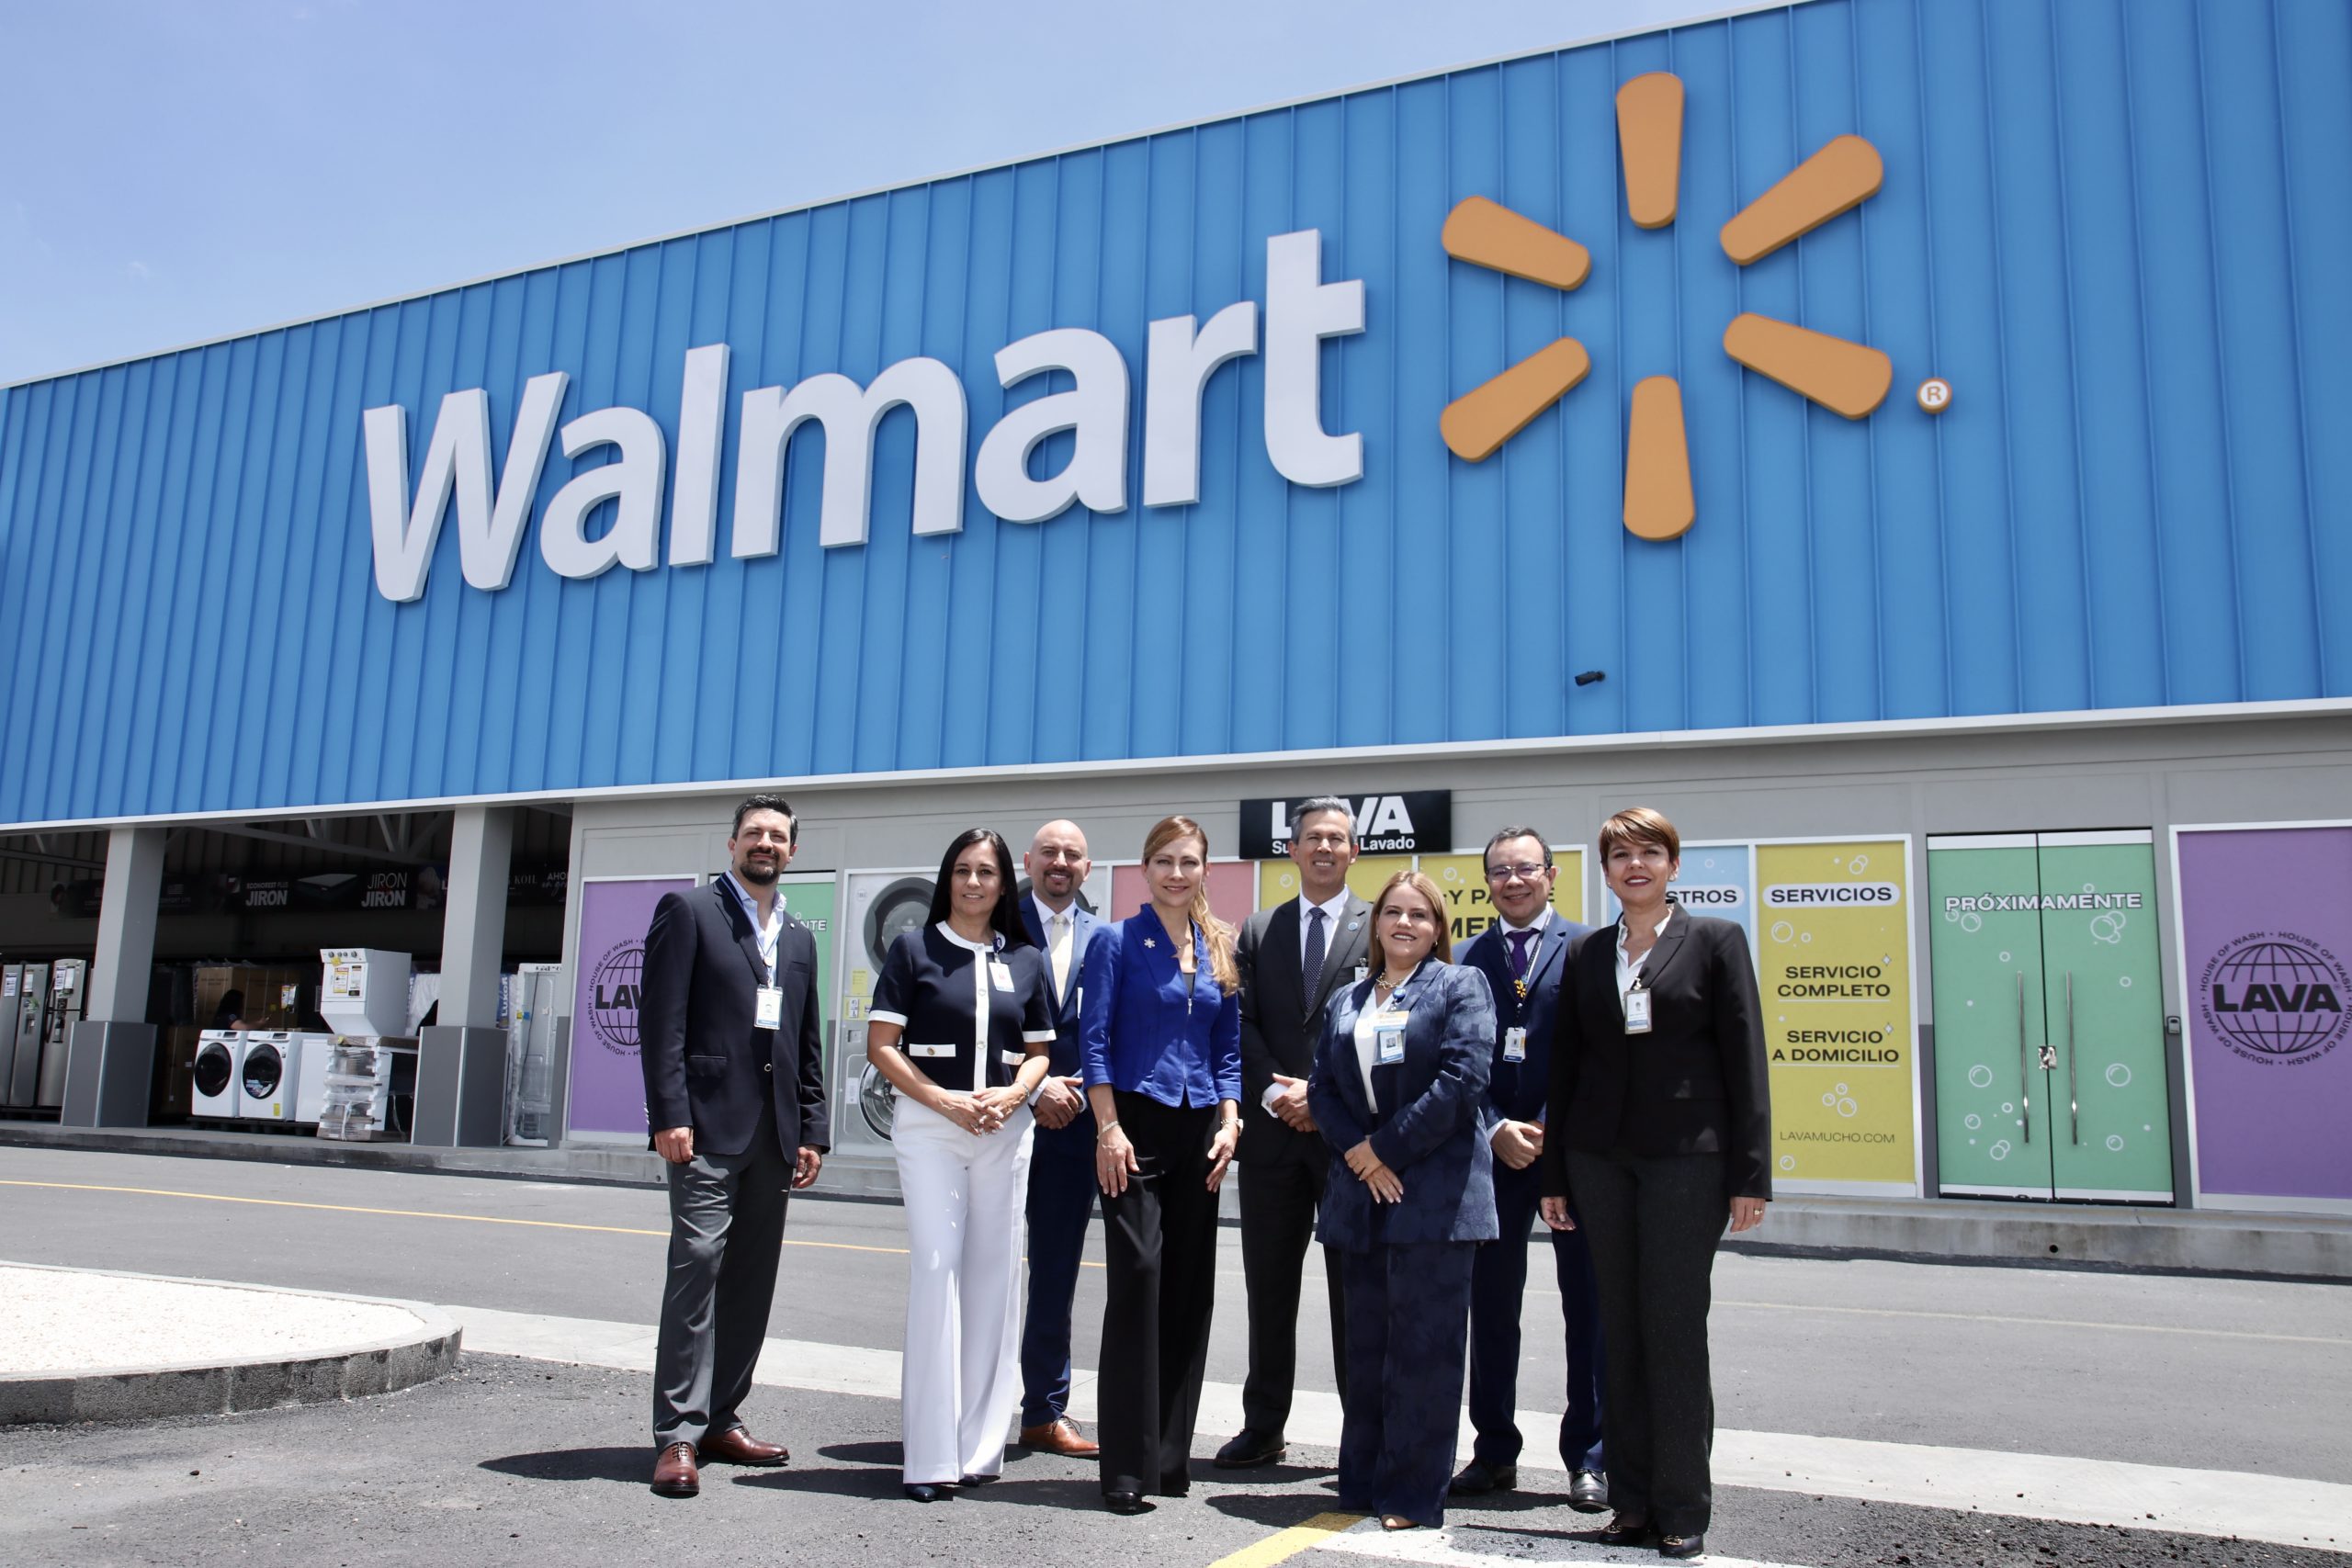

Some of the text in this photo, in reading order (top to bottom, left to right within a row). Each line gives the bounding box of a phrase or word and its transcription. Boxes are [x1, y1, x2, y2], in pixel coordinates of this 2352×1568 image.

[364, 228, 1365, 603] Walmart
[1272, 795, 1415, 839] LVA
[1360, 837, 1416, 851] Lavado
[368, 872, 407, 889] JIRON
[547, 872, 567, 881] AHO
[245, 890, 288, 906] JIRON
[361, 889, 405, 907] JIRON
[1665, 889, 1737, 904] STROS
[1770, 887, 1892, 903] SERVICIOS
[1945, 892, 2143, 911] PRÓXIMAMENTE
[589, 938, 633, 992] HOUSE OF WASH
[2199, 931, 2265, 992] HOUSE OF WASH
[2278, 931, 2321, 951] HOUSE
[2320, 948, 2335, 961] OF
[2334, 962, 2352, 993] WASH
[1785, 965, 1882, 979] SERVICIO
[595, 985, 641, 1010] LAV
[1777, 984, 1891, 998] COMPLETO
[2212, 984, 2342, 1012] LAVA
[1787, 1030, 1883, 1043] SERVICIO
[1772, 1048, 1899, 1062] A DOMICILIO
[1780, 1131, 1895, 1144] LAVAMUCHO.COM
